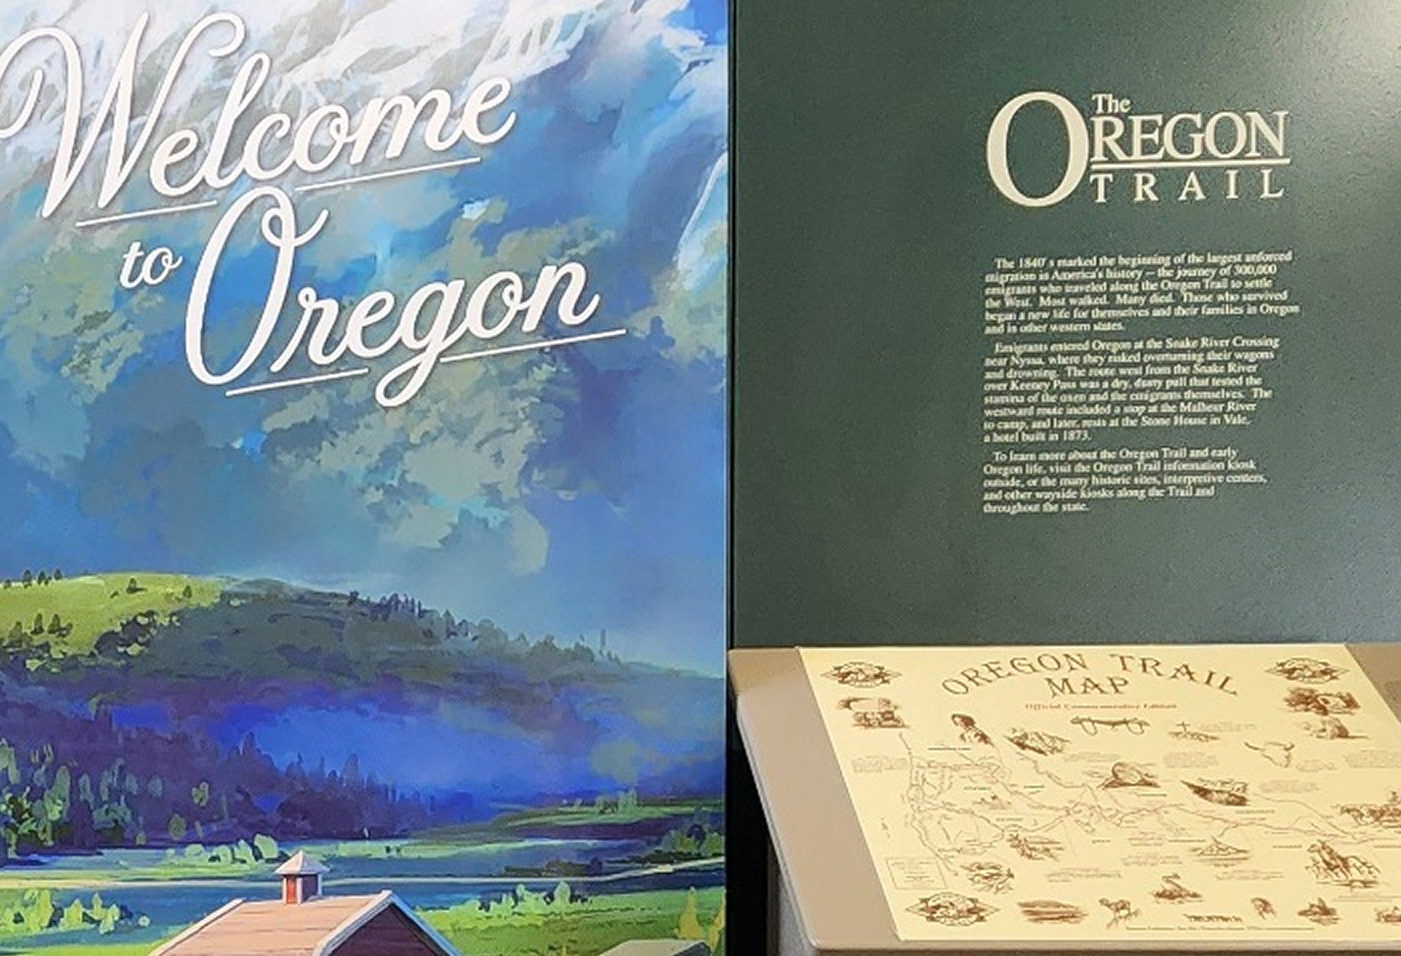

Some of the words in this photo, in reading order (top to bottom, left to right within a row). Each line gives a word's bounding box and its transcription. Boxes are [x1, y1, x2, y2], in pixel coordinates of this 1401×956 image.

[1091, 92, 1131, 114] The
[986, 91, 1289, 207] OREGON
[1089, 169, 1285, 203] TRAIL
[1039, 271, 1049, 280] in
[117, 238, 184, 290] to
[183, 186, 600, 408] Oregon
[1247, 305, 1256, 314] in
[1007, 324, 1016, 333] in
[941, 653, 1089, 696] OREGON
[1109, 653, 1239, 697] TRAIL
[1044, 676, 1130, 698] MAP
